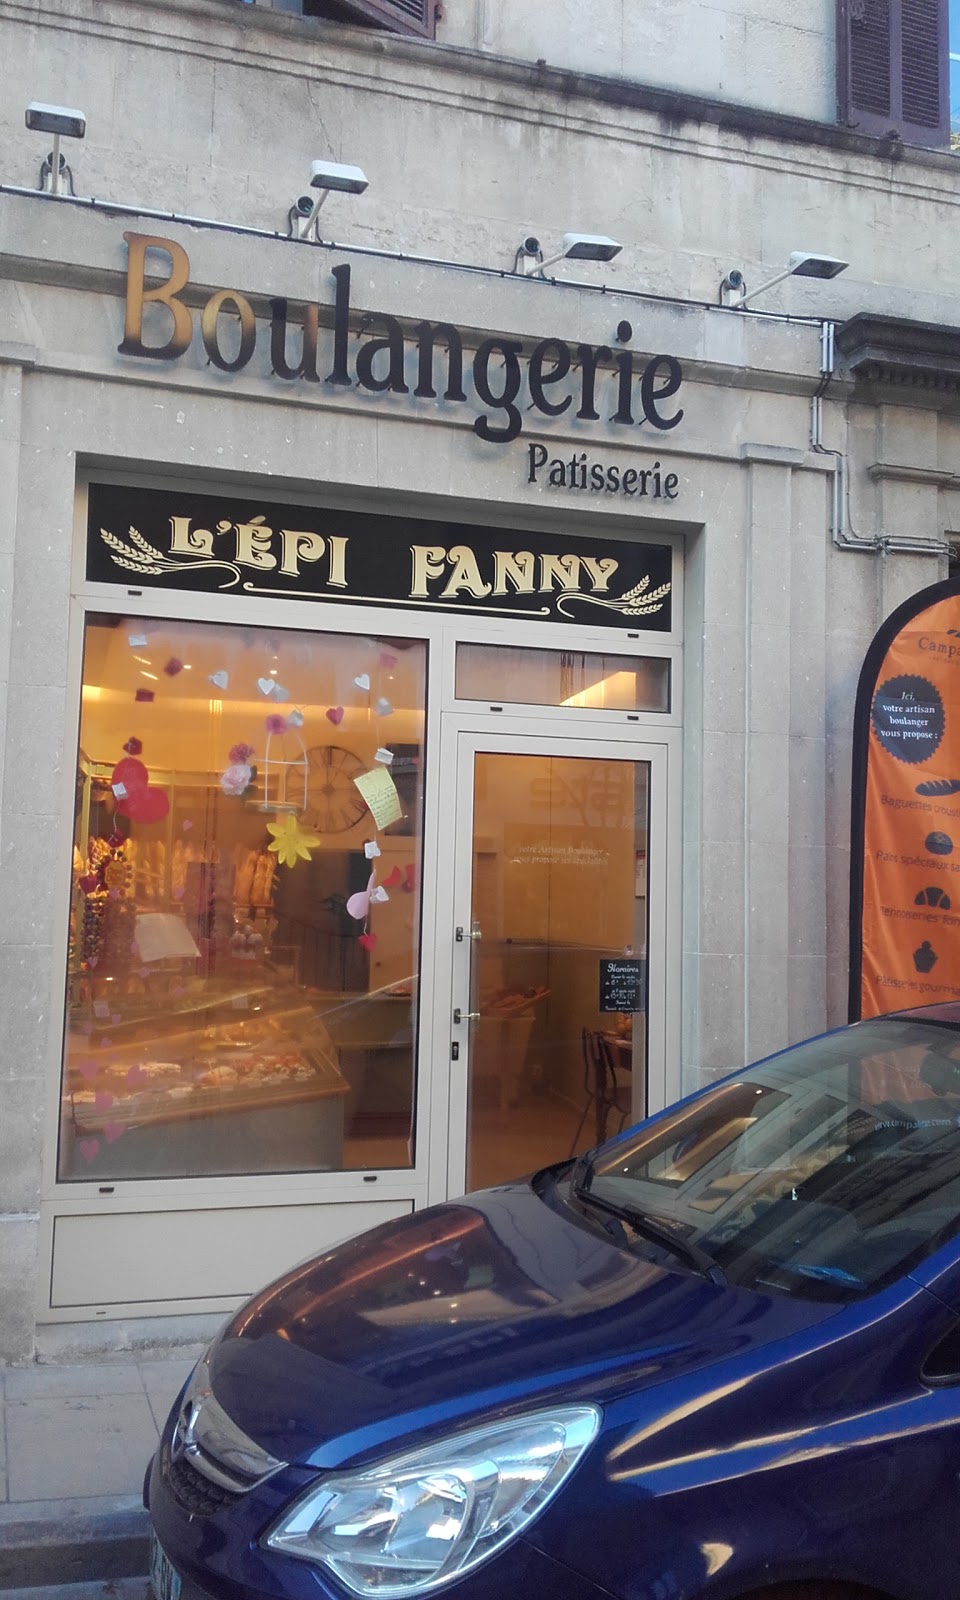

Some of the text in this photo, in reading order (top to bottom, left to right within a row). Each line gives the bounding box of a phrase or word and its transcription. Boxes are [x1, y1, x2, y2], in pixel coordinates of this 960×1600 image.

[118, 231, 684, 443] Boulangerie
[528, 443, 680, 500] Patisserie
[169, 515, 619, 598] L'ÉPI FANNY
[901, 691, 915, 701] Ici,
[882, 704, 935, 714] votre artisan
[889, 715, 929, 728] boulanger
[903, 731, 933, 740] propose
